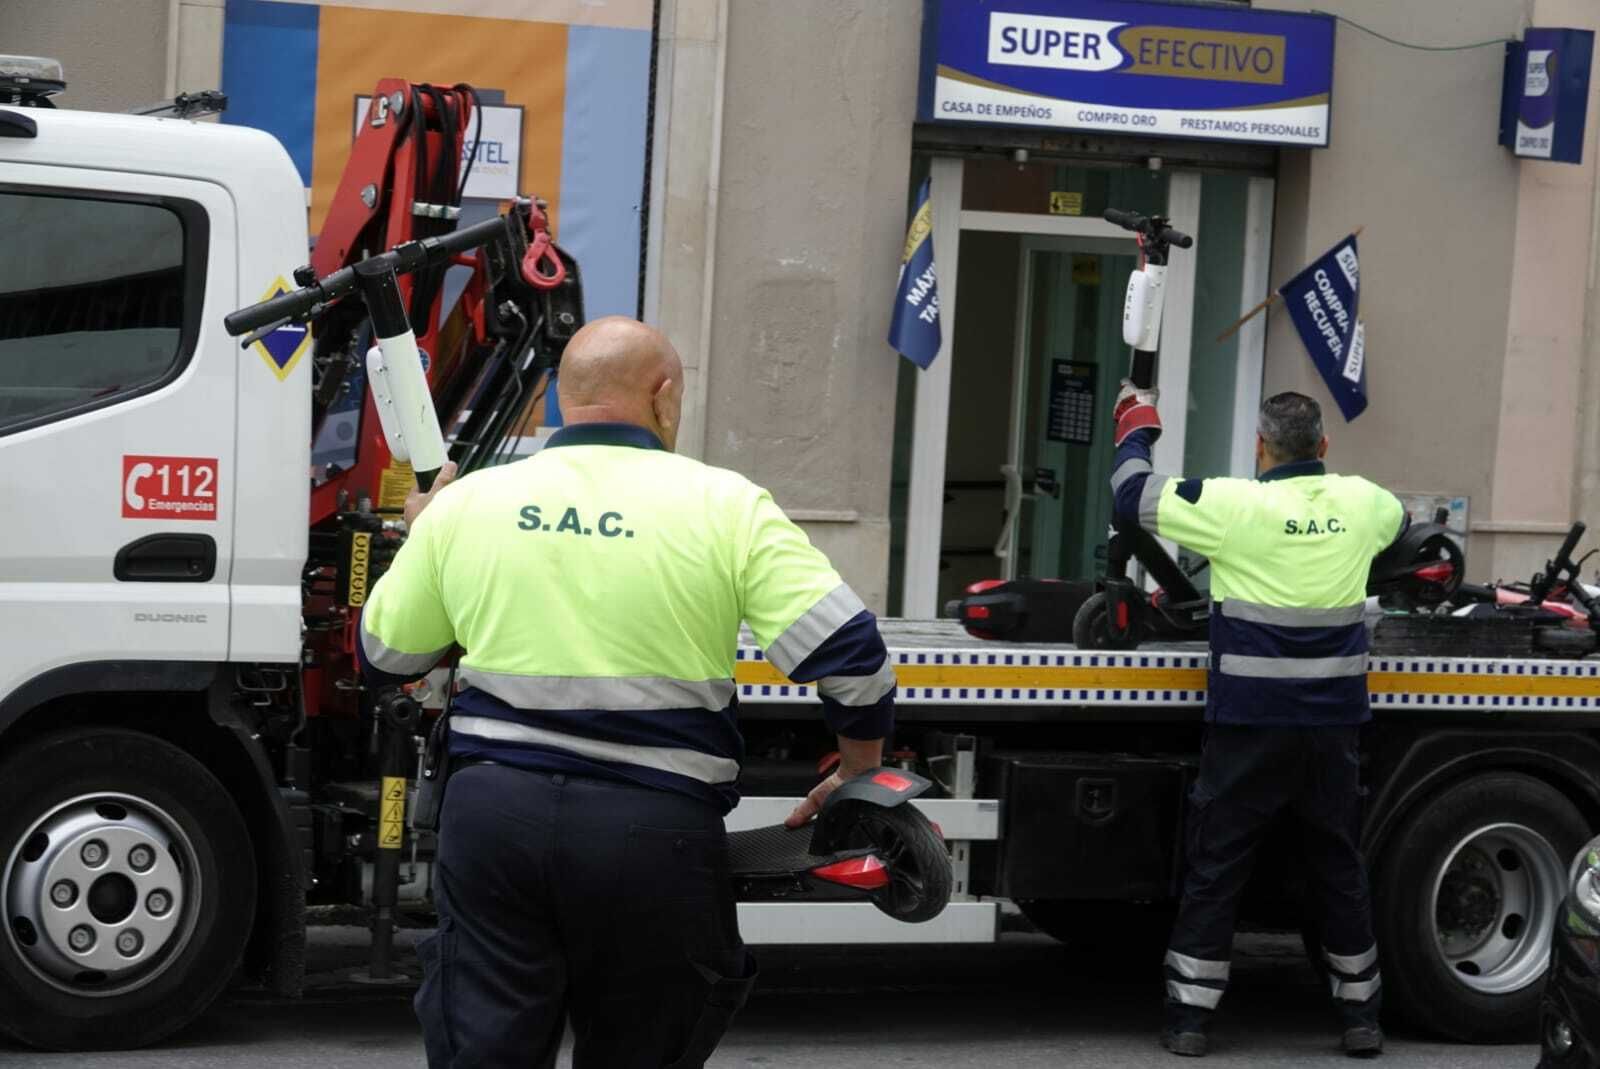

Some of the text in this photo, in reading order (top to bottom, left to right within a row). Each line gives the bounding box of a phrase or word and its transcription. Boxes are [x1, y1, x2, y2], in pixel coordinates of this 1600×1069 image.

[1000, 26, 1274, 74] SUPER EFECTIVO
[942, 100, 1053, 120] CASA DE EMPEÑOS
[1077, 110, 1157, 127] COMPRO ORO
[1180, 117, 1320, 138] PRESTAMOS PERSONALES
[156, 464, 213, 497] 112
[148, 498, 214, 512] Emergencias
[517, 504, 635, 538] S.A.C.
[1283, 518, 1346, 535] S.A.C.
[133, 613, 207, 623] DUONIC
